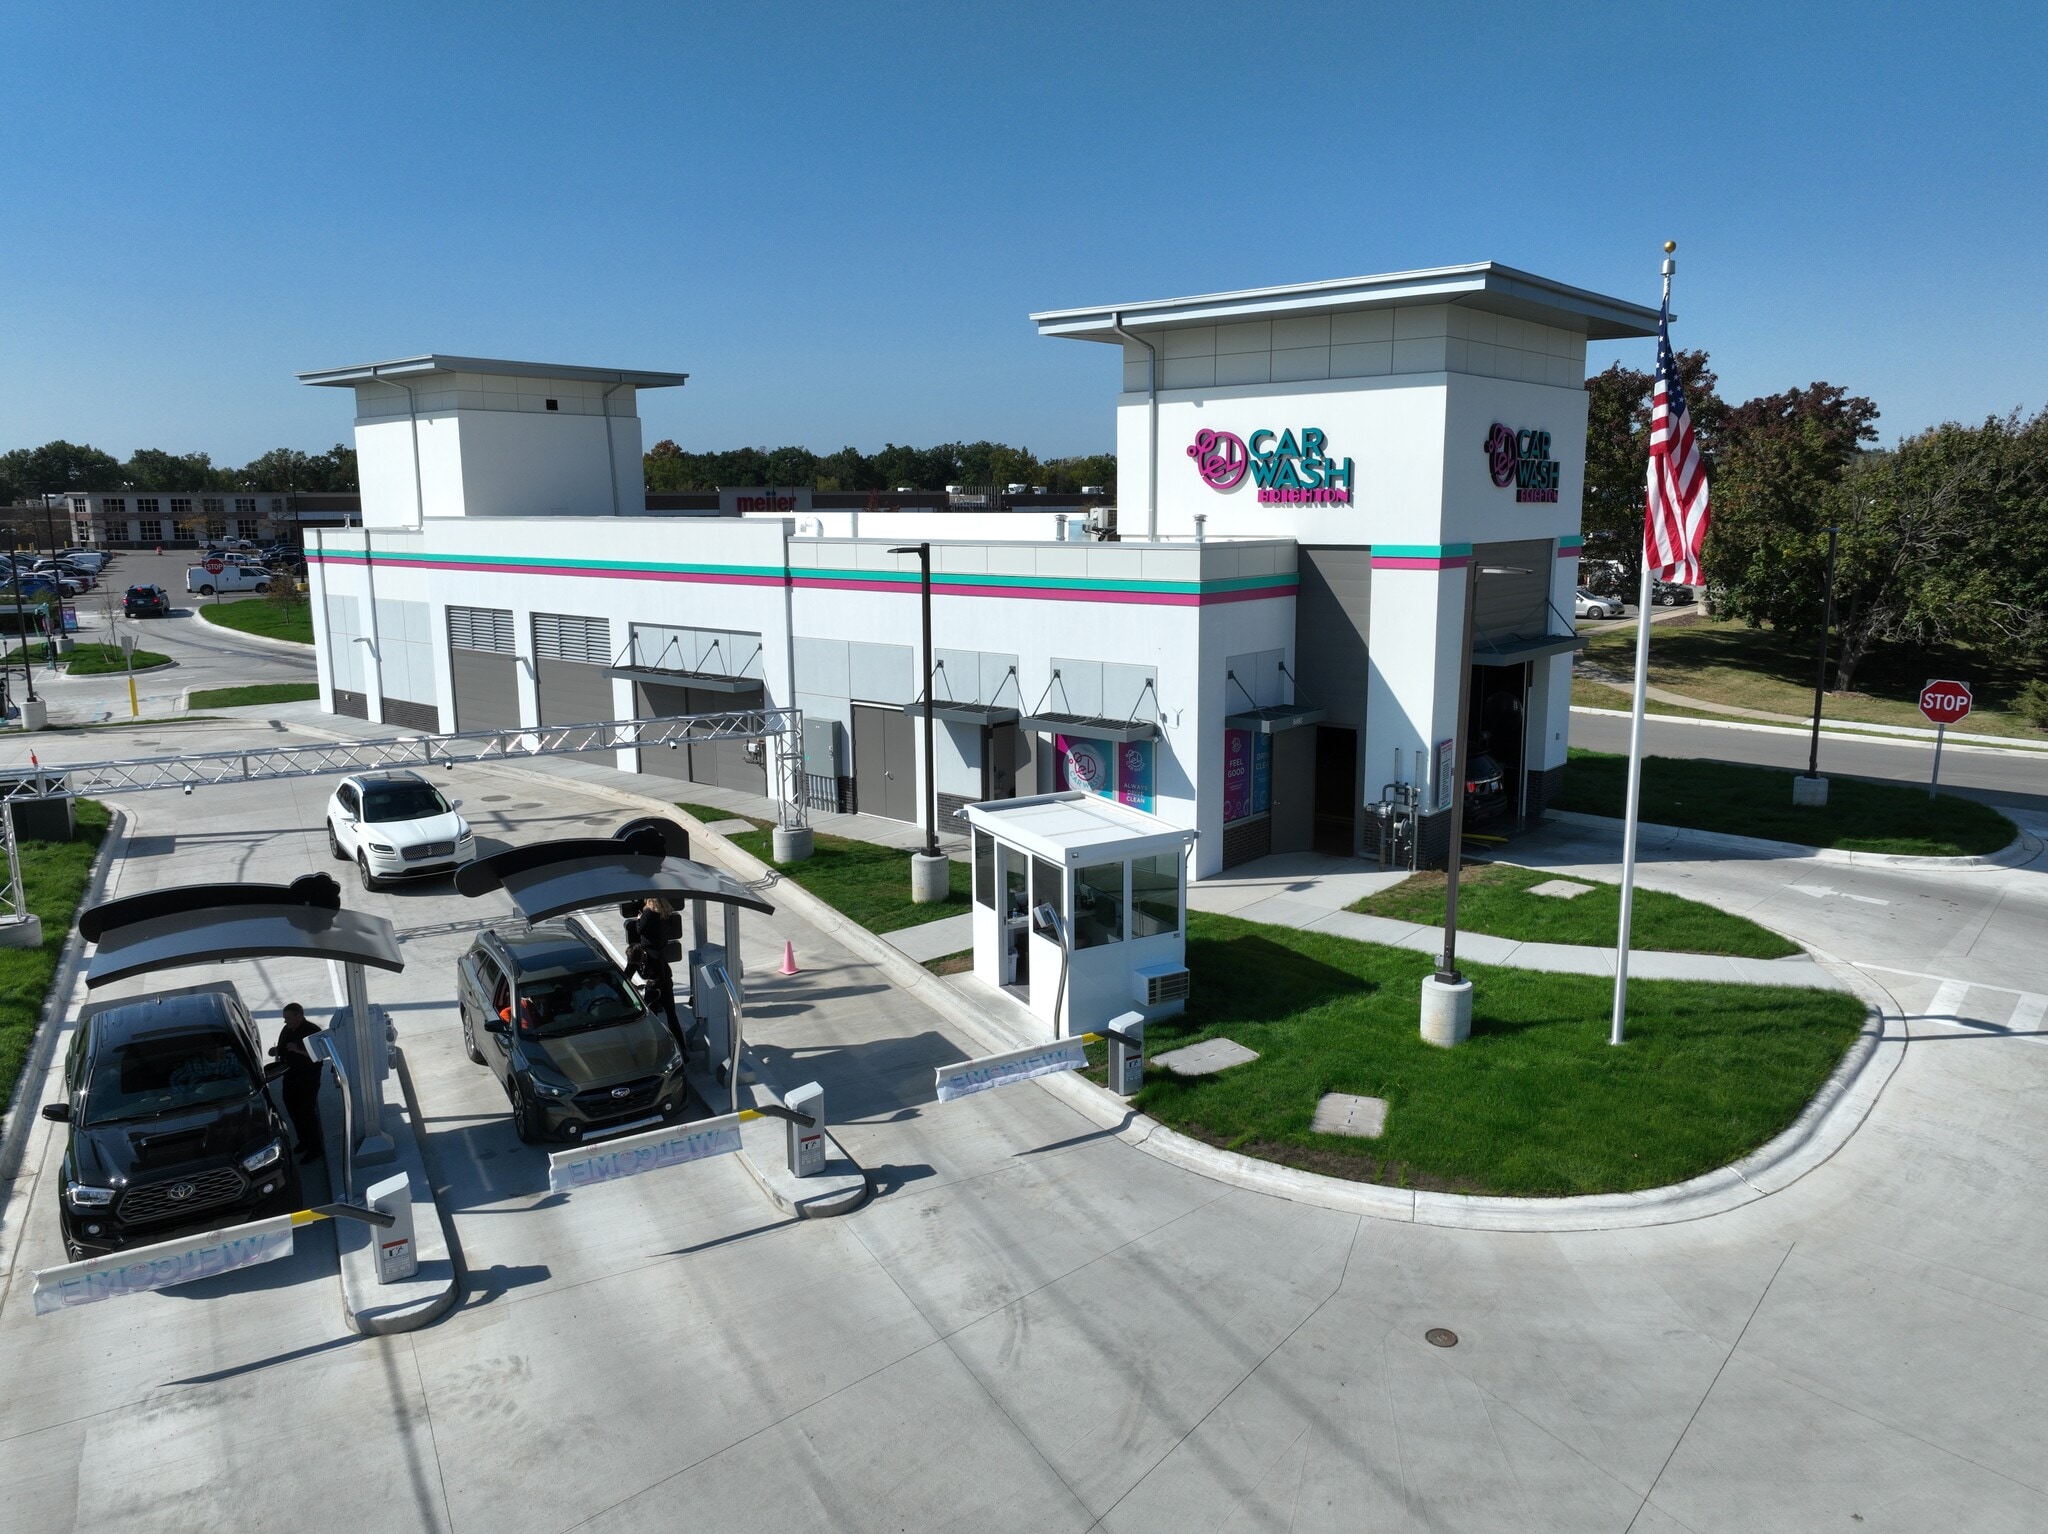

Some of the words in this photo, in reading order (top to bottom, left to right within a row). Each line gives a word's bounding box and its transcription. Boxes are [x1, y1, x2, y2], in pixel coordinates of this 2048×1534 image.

[1249, 428, 1326, 459] CAR
[1516, 429, 1551, 460] CAR
[1250, 457, 1354, 488] WASH
[1516, 460, 1560, 488] WASH
[736, 491, 797, 512] meijer
[1257, 489, 1350, 503] BRIGHTON
[1516, 488, 1559, 503] BRIGHTON
[1923, 693, 1968, 712] STOP
[1229, 758, 1243, 767] FEEL
[1227, 767, 1245, 778] GOOD
[1123, 782, 1148, 791] ALWAYS
[1126, 795, 1145, 804] CLEAN
